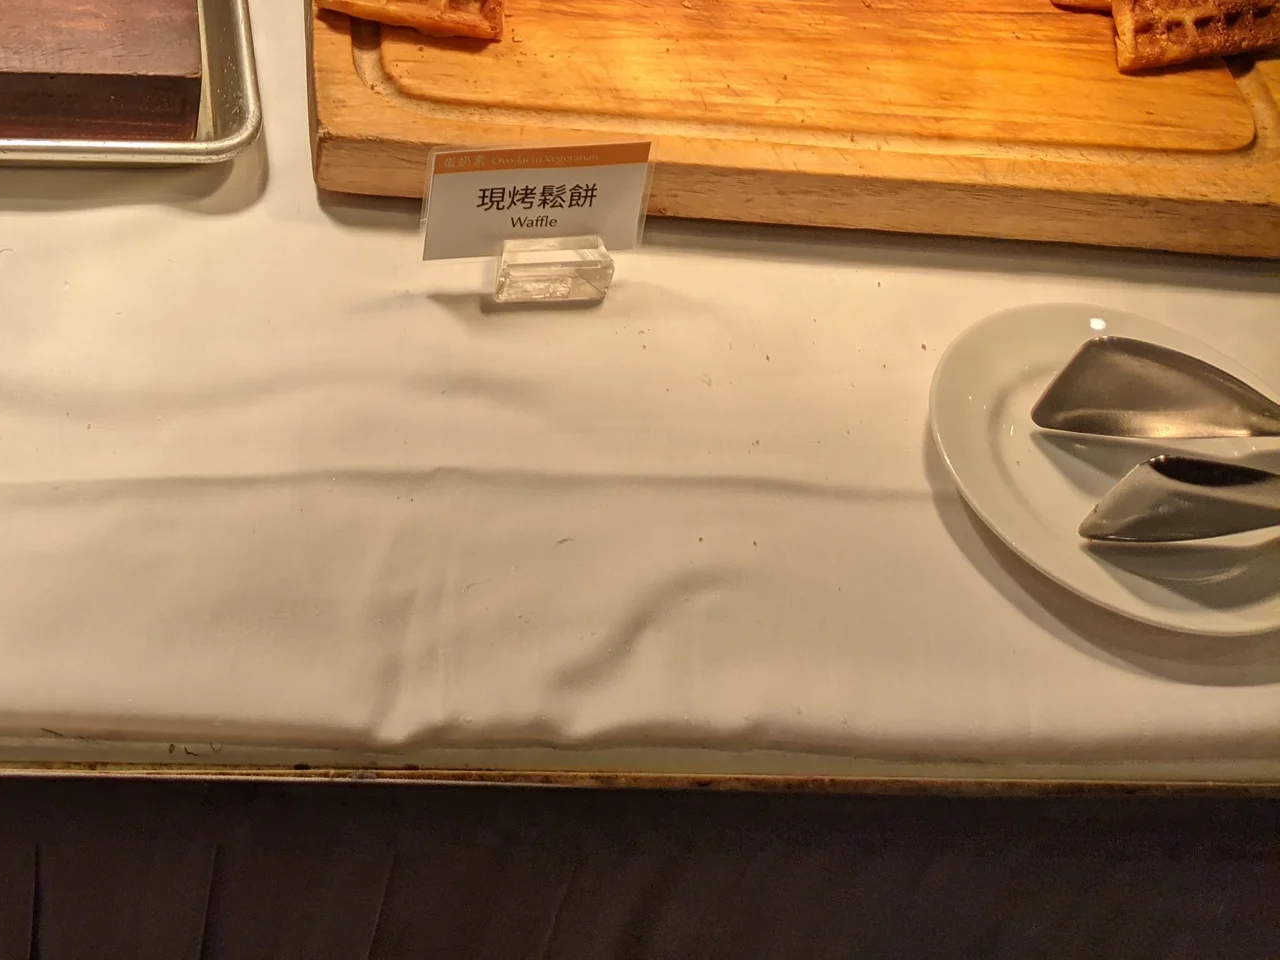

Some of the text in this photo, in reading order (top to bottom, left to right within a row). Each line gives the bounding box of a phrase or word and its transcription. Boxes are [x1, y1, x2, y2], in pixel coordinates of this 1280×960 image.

[476, 182, 598, 212] 現烤鬆餅
[510, 215, 558, 228] Waffle
